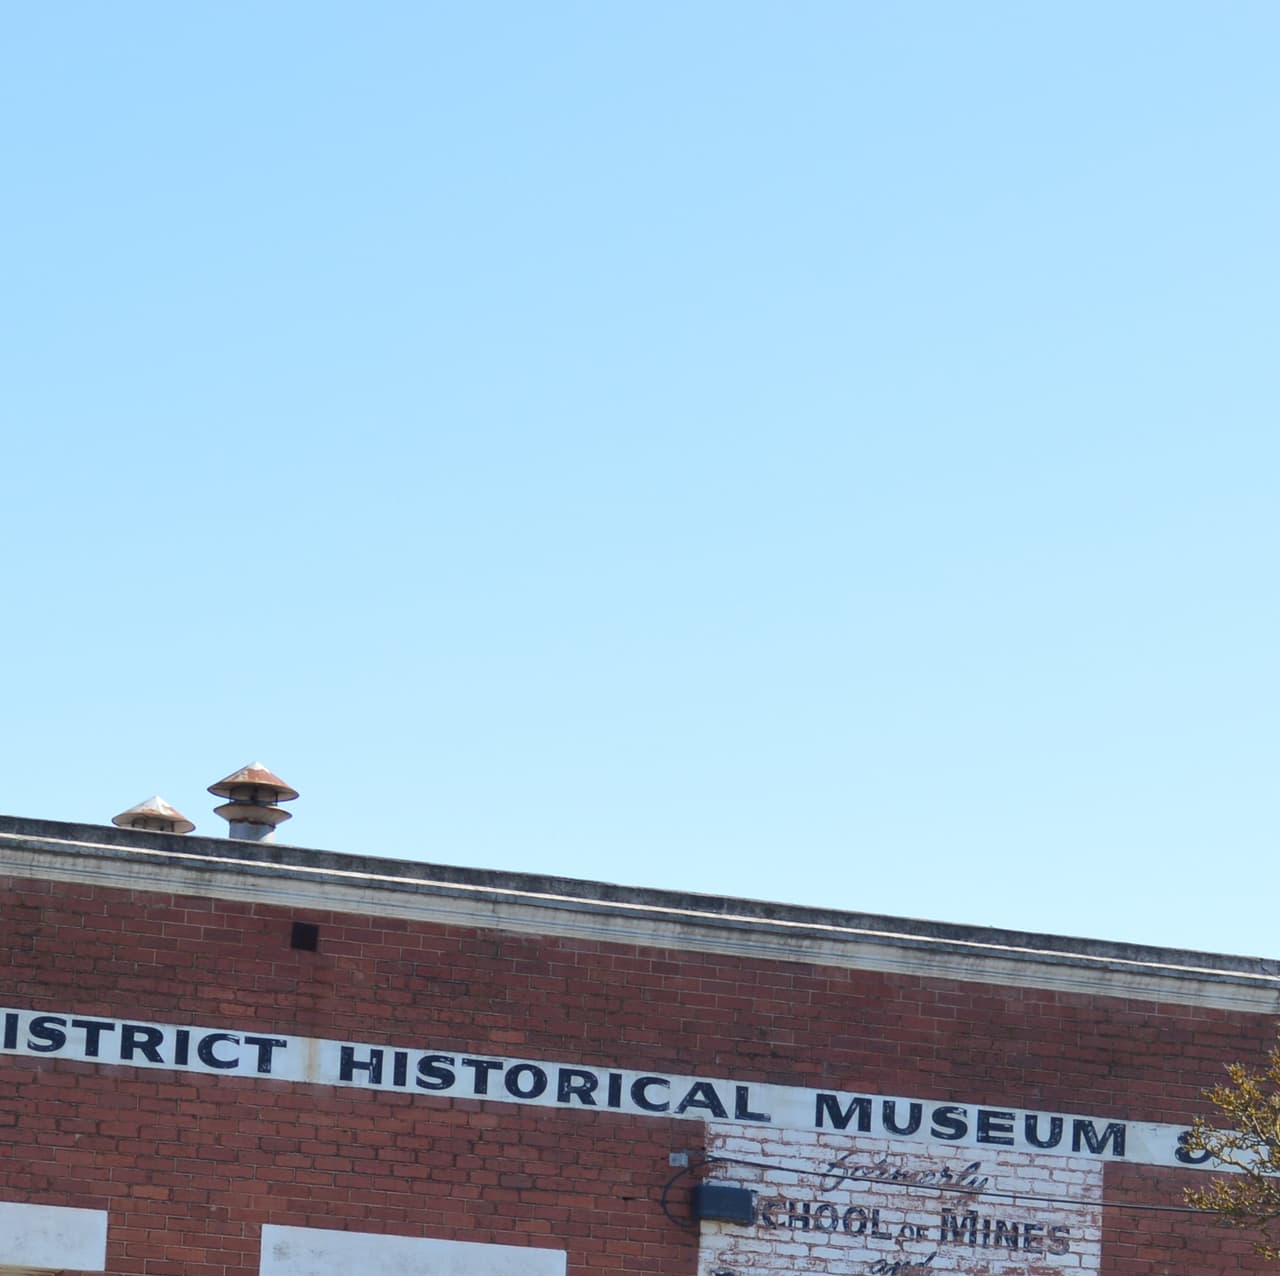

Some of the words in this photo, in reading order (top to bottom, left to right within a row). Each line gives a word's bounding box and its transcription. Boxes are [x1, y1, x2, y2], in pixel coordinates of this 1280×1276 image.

[338, 1045, 772, 1123] HISTORICAL
[814, 1093, 1126, 1157] MUSEUM
[760, 1201, 893, 1241] CHOOL
[940, 1207, 1072, 1256] MINES
